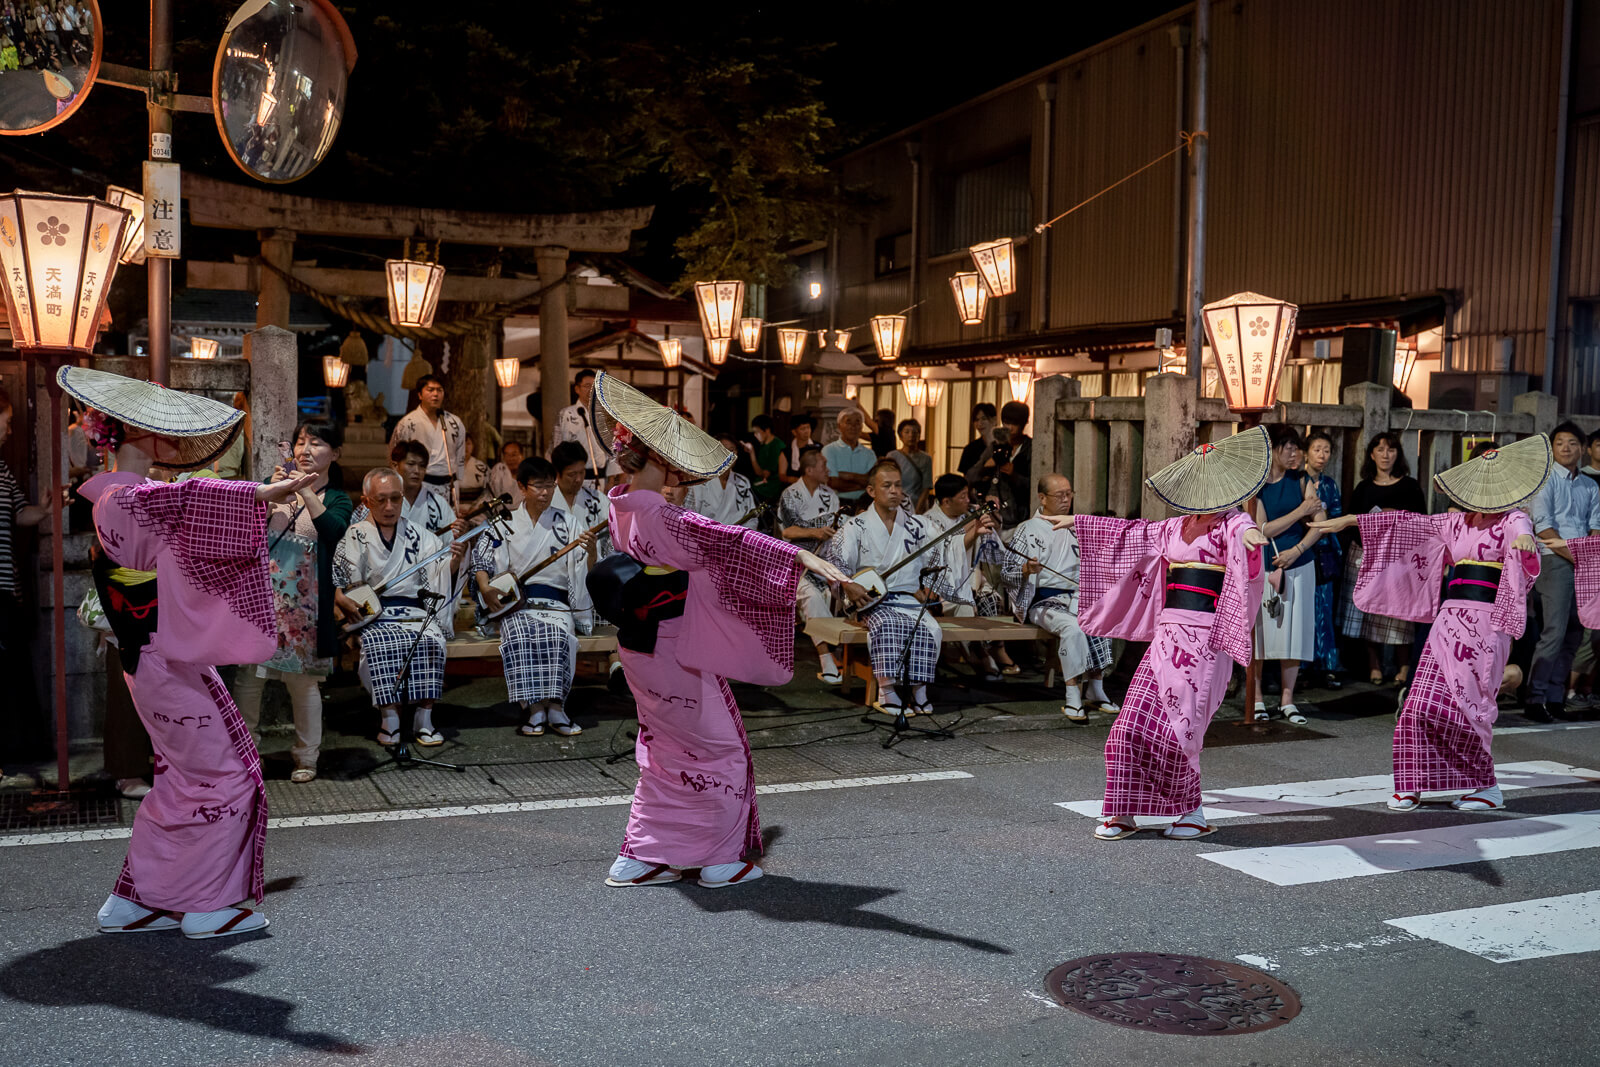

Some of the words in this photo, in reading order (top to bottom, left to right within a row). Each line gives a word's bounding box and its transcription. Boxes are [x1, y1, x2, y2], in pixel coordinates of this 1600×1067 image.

[152, 199, 174, 250] 注意
[45, 267, 62, 317] 天満町
[80, 271, 97, 320] 天満町
[1226, 353, 1240, 388] 天満町
[1251, 351, 1263, 387] 天満町
